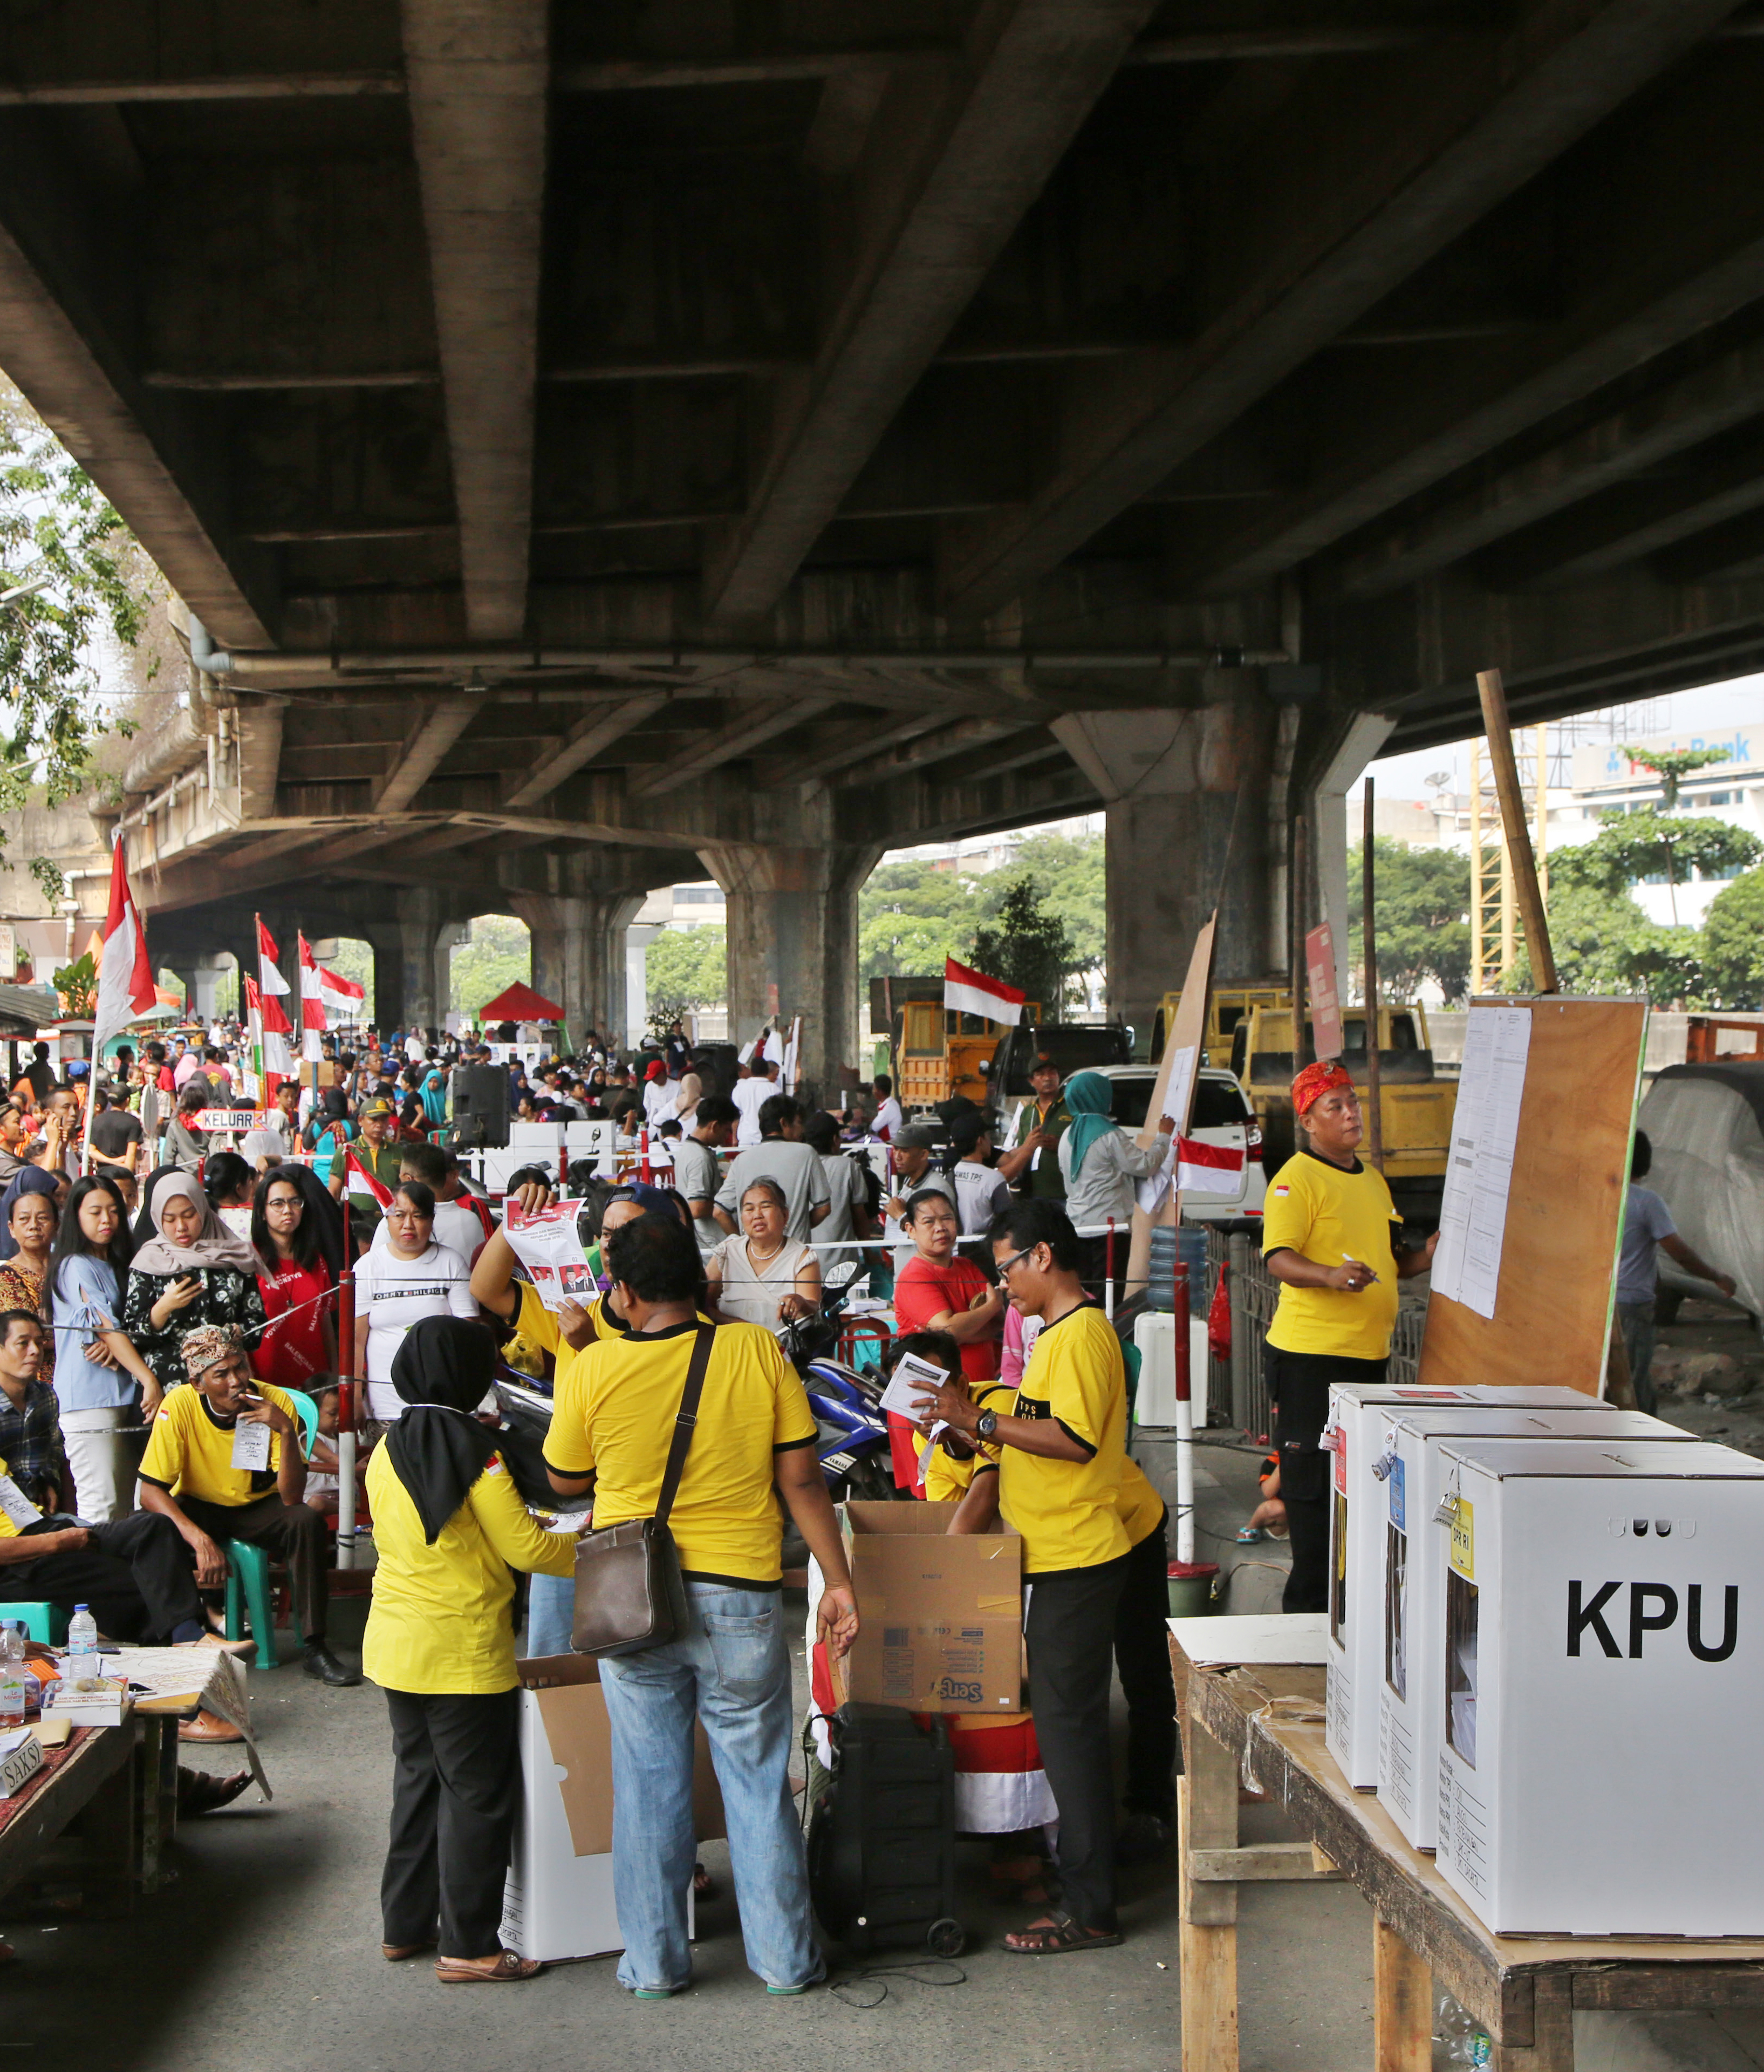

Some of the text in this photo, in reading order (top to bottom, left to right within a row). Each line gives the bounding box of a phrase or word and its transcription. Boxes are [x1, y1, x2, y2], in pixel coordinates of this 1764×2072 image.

[204, 1113, 252, 1127] KELUAR
[971, 1173, 982, 1181] TPS
[284, 1342, 315, 1373] BALENCIAGA
[1020, 1401, 1036, 1414] TPS
[829, 1457, 847, 1469] YAMAHA
[1453, 1526, 1469, 1551] DPR RI
[1567, 1579, 1739, 1662] KPU
[4, 1743, 40, 1788] SAKSI
